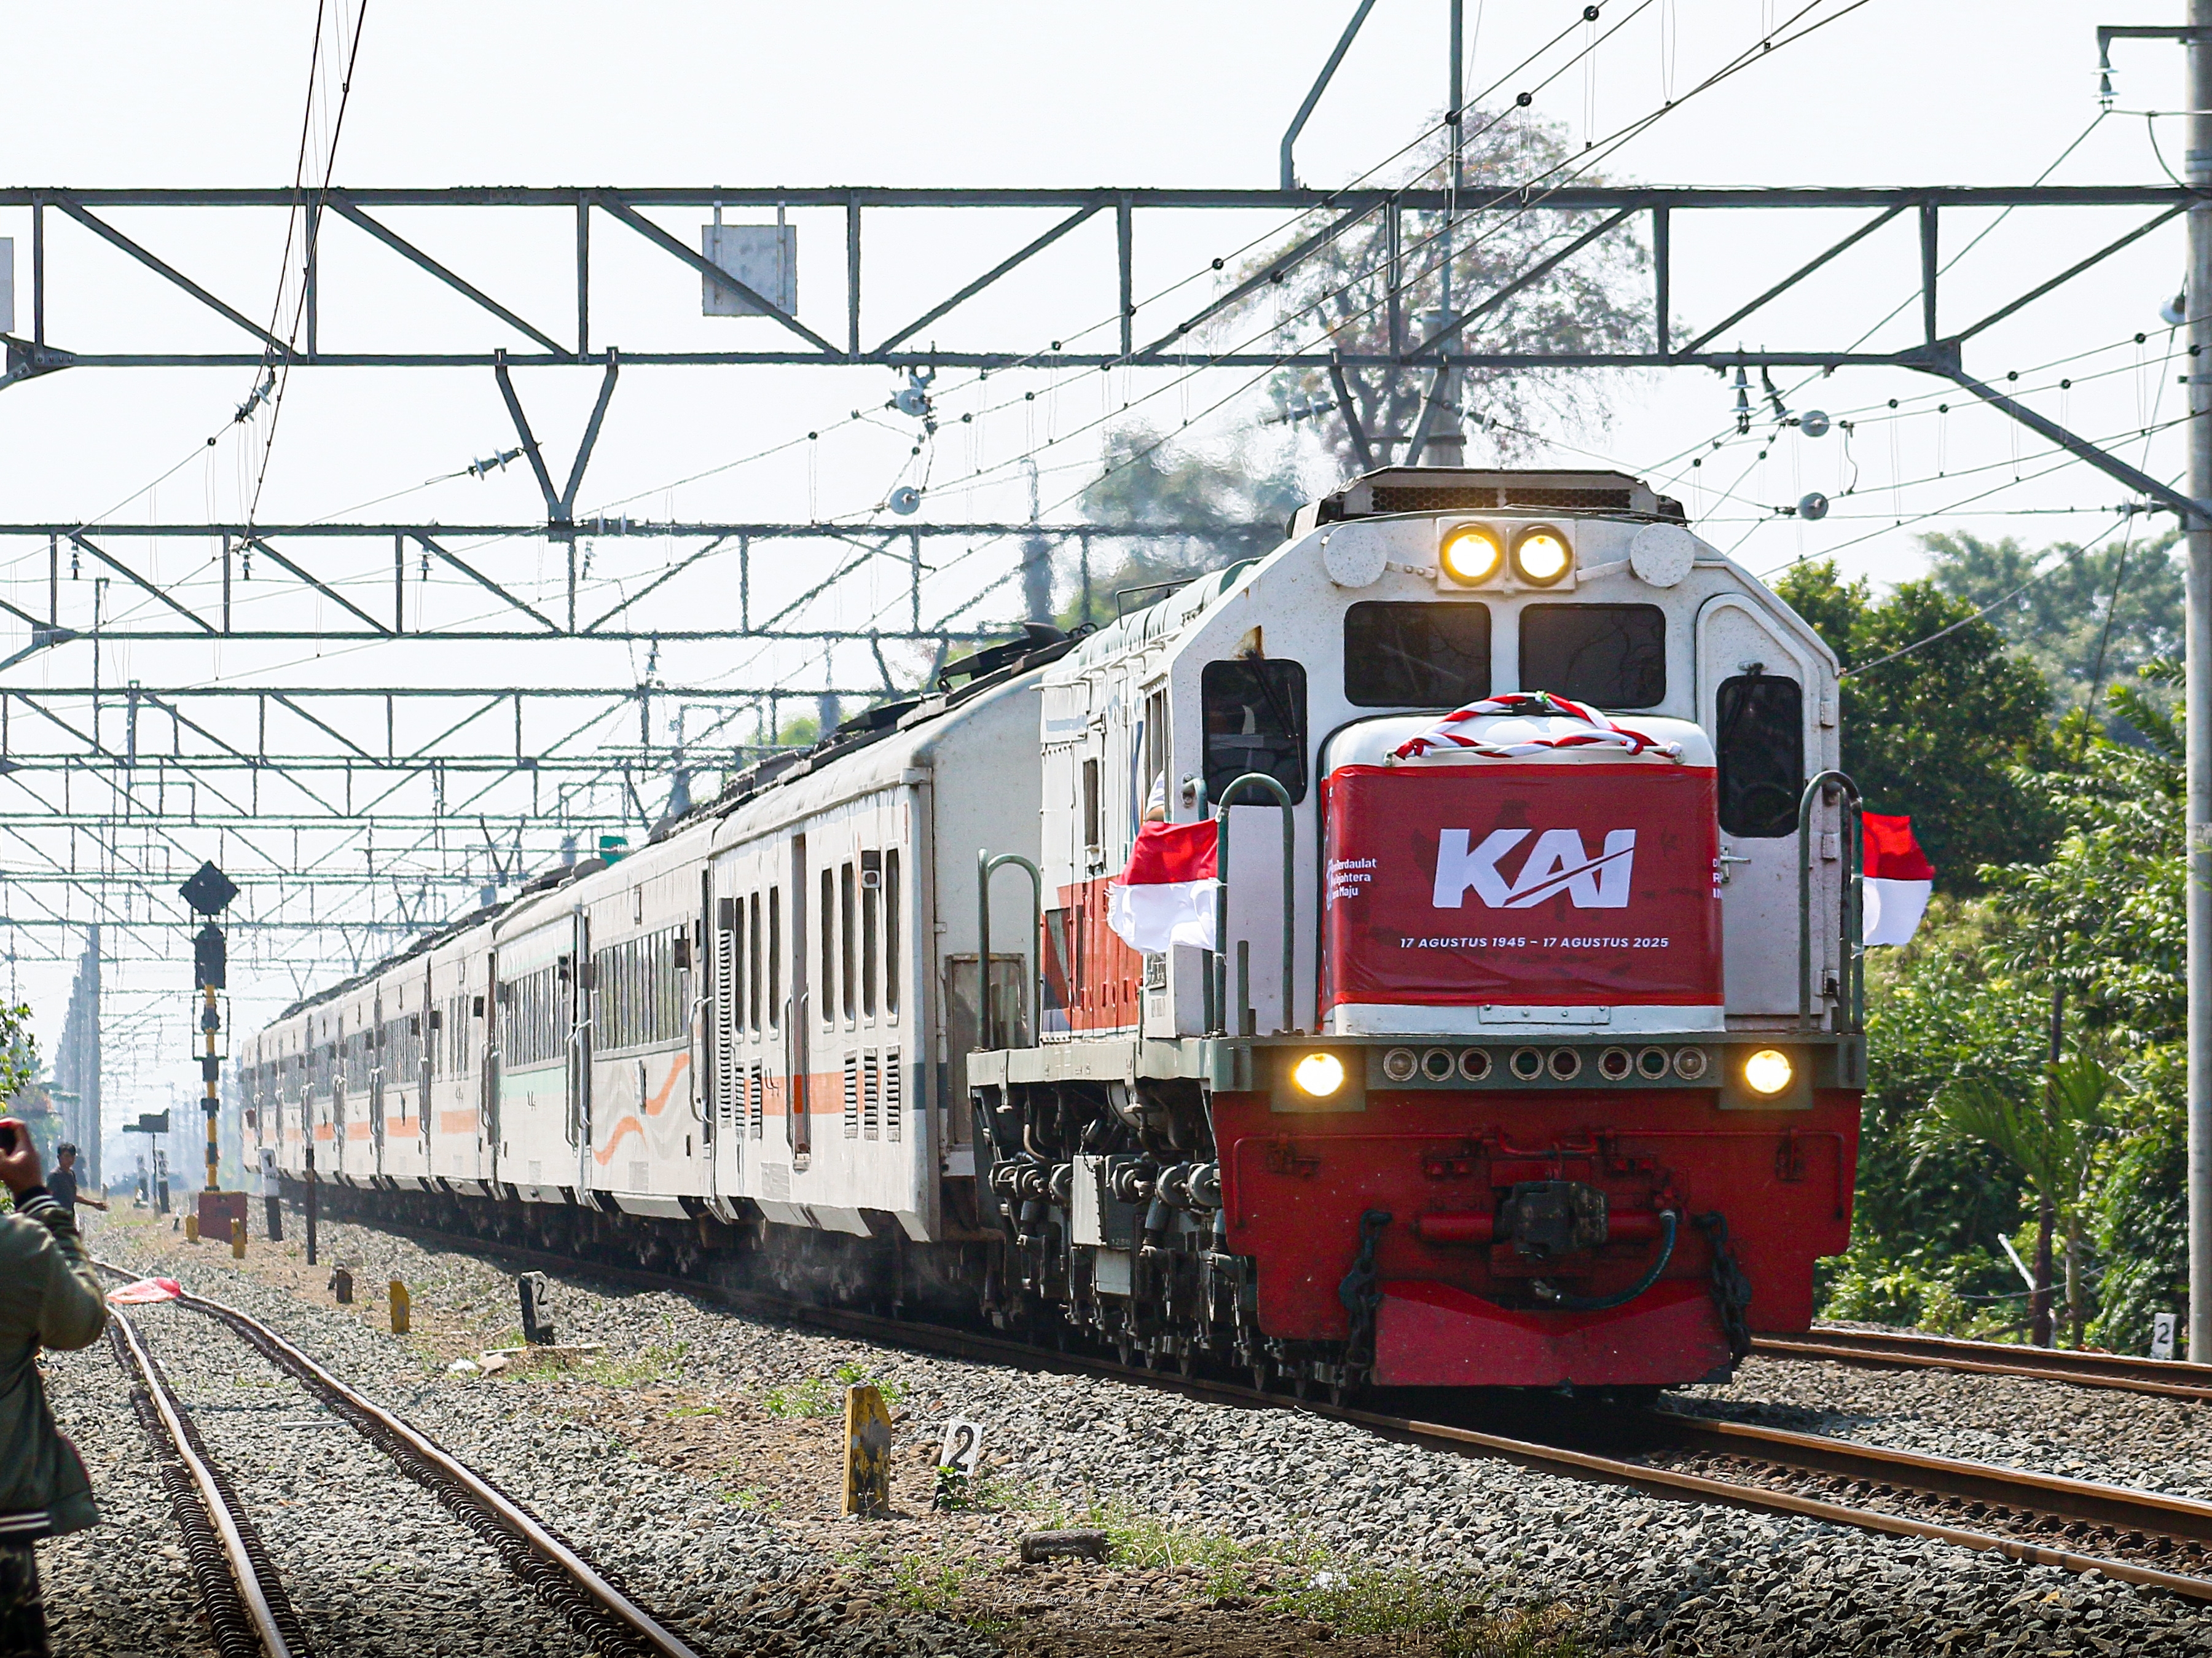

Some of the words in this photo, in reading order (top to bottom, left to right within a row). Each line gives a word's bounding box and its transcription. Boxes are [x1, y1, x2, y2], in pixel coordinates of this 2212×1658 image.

[1432, 829, 1636, 908] KAI
[1339, 885, 1359, 899] Maju
[1400, 938, 1414, 948] 17
[1418, 937, 1488, 948] AGUSTUS
[1492, 937, 1526, 947] 1945
[1543, 937, 1558, 947] 17
[1560, 937, 1629, 948] AGUSTUS
[1633, 937, 1669, 948] 2025
[536, 1281, 547, 1305] 2
[2157, 1322, 2170, 1345] 2
[947, 1425, 974, 1472] 2
